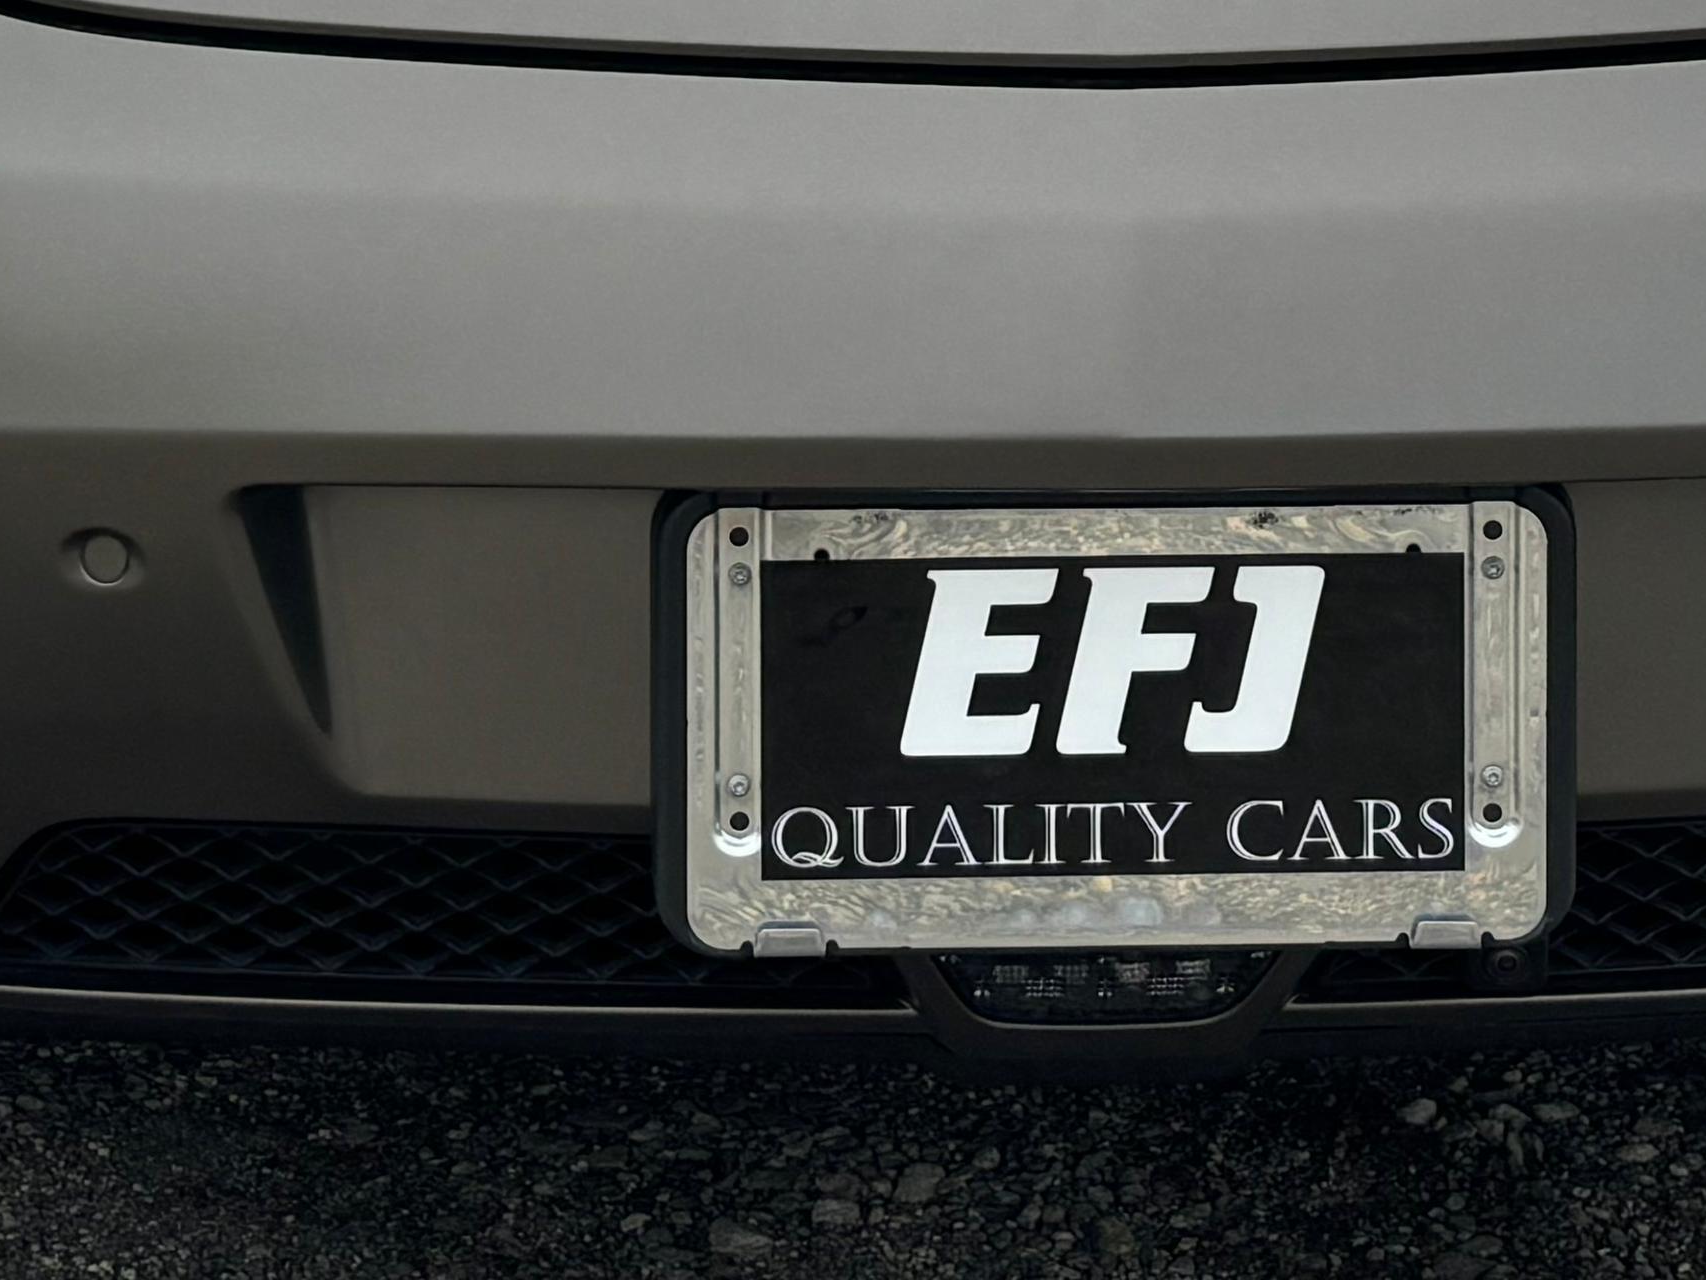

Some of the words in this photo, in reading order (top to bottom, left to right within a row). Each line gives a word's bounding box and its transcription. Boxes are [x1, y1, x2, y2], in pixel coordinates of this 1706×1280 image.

[900, 565, 1326, 757] EFJ
[771, 801, 1192, 870] QUALITY
[1225, 797, 1456, 862] CARS
